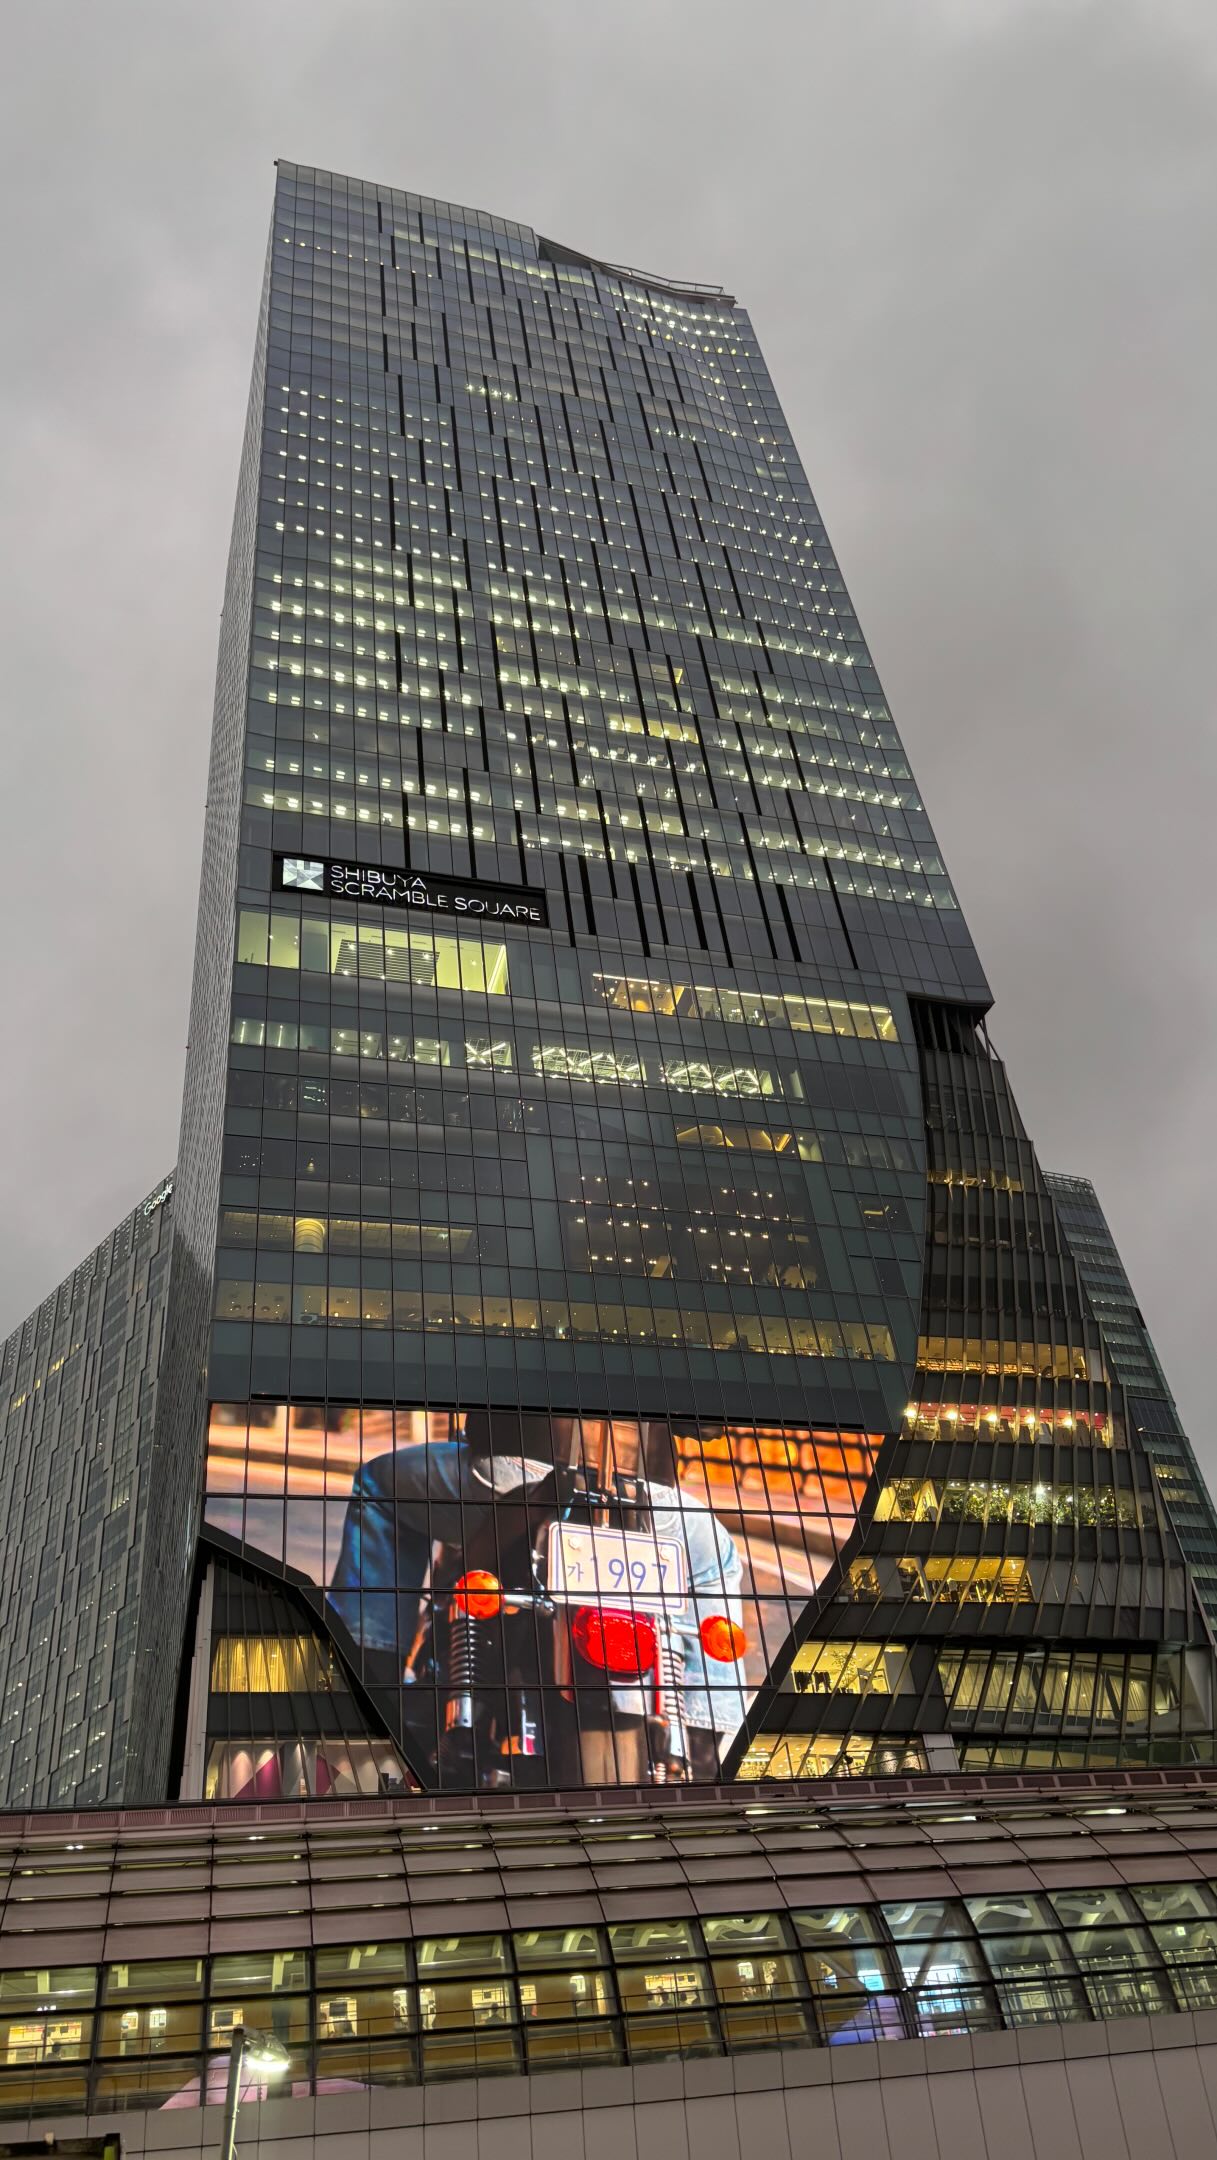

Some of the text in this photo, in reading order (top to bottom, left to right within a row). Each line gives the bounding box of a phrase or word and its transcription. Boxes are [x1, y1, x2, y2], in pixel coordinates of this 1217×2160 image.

[330, 865, 427, 890] SHIBUYA
[330, 880, 541, 921] SCRAMBLE SQUARE
[144, 1183, 173, 1216] Google
[590, 1557, 667, 1590] 997
